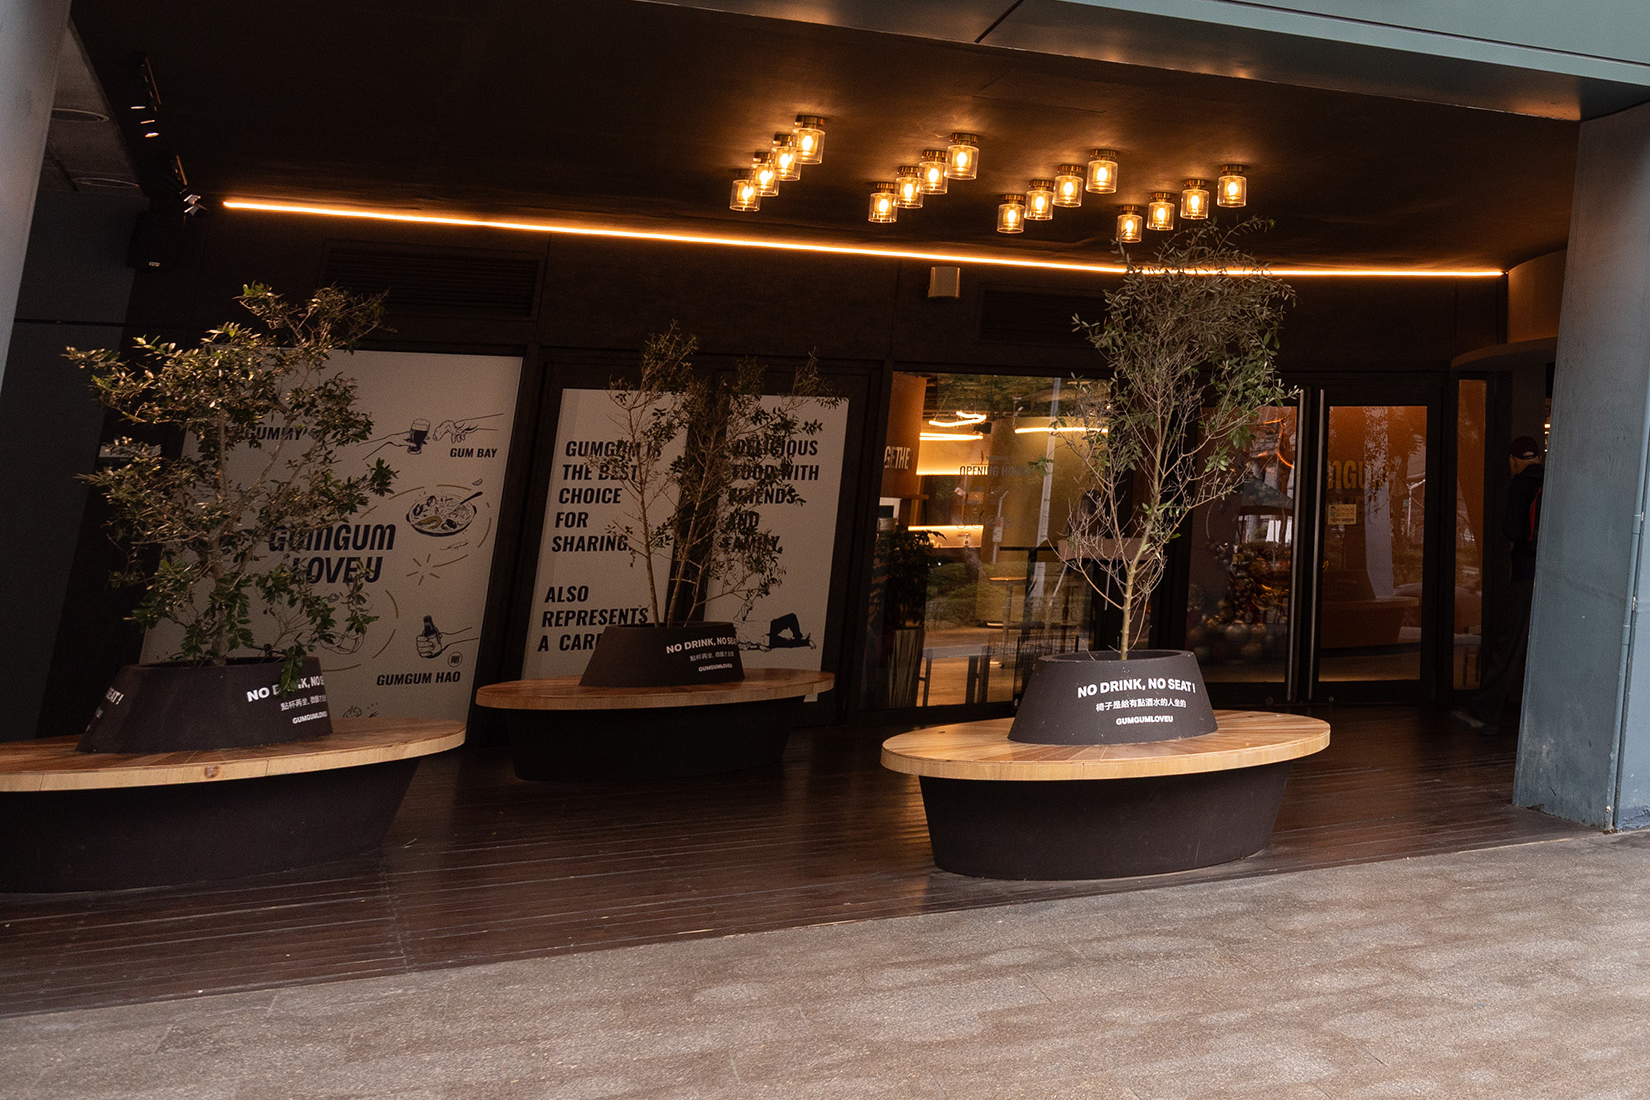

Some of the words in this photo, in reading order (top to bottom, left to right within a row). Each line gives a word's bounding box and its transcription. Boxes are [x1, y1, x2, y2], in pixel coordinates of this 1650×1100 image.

[450, 448, 474, 458] GUM
[477, 448, 498, 458] BAY
[563, 464, 592, 481] THE
[599, 465, 638, 481] BEST
[779, 465, 819, 481] WITH
[559, 487, 623, 504] CHOICE
[555, 512, 589, 528] FOR
[544, 586, 589, 603] ALSO
[541, 607, 649, 628] REPRESENTS
[537, 635, 550, 652] A
[665, 644, 682, 655] NO
[684, 638, 716, 651] DRINK,
[716, 637, 727, 646] NO
[376, 673, 433, 686] GUMGUM
[436, 671, 461, 683] HAO
[246, 686, 271, 703] NO
[310, 675, 320, 687] NO
[1077, 684, 1098, 699] NO
[1100, 678, 1146, 694] DRINK,
[1147, 677, 1166, 690] NO
[1115, 715, 1174, 726] GUMGUMLOVEU
